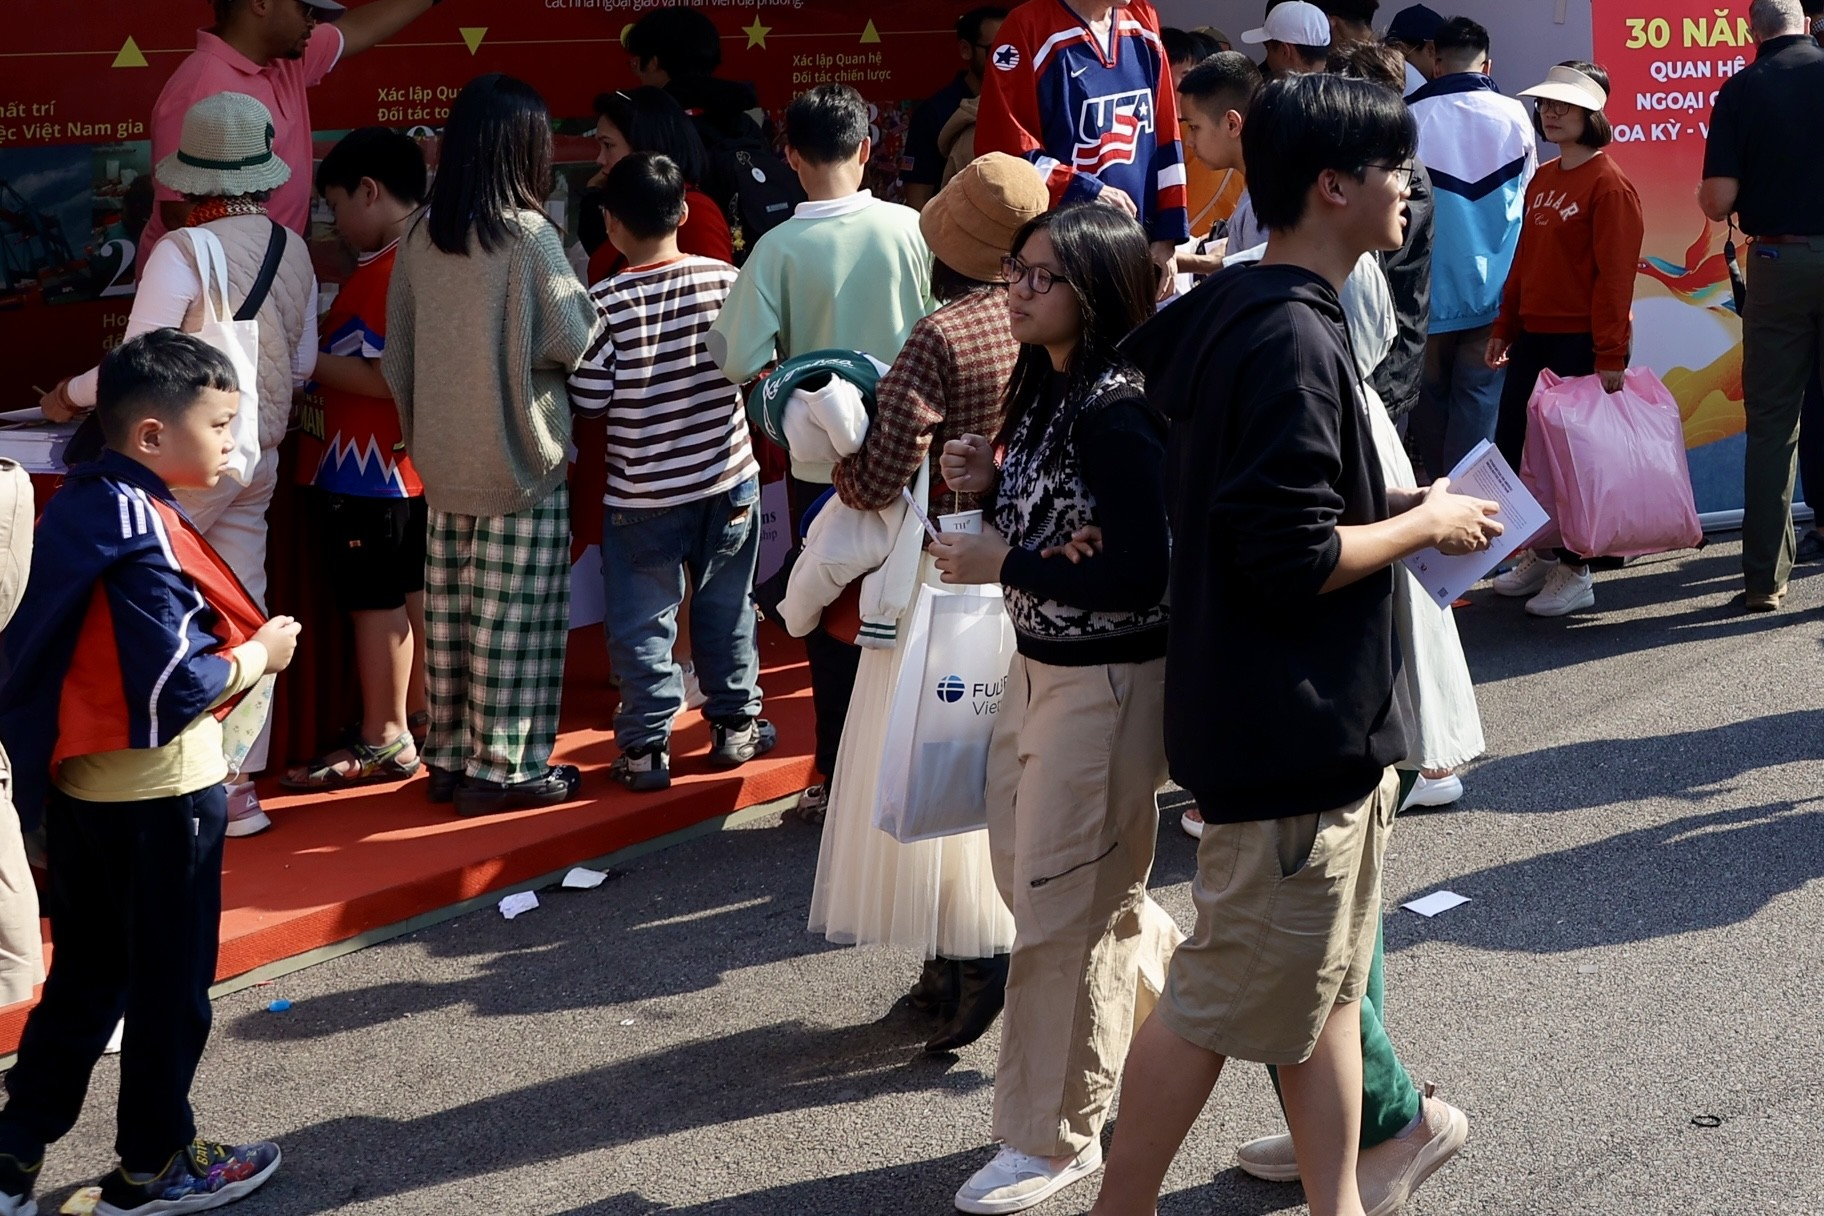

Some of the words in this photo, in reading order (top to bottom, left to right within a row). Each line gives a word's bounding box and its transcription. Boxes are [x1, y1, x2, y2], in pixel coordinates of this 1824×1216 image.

[1625, 17, 1670, 49] 30
[793, 53, 813, 67] Xác
[816, 52, 833, 68] lập
[836, 53, 865, 67] Quan
[868, 51, 882, 67] hệ
[793, 71, 812, 84] Đối
[814, 70, 832, 83] tác
[867, 68, 892, 83] lược
[1650, 61, 1711, 82] QUAN
[378, 87, 405, 102] Xác
[409, 85, 432, 103] lập
[1637, 92, 1703, 114] NGOẠI
[32, 100, 56, 116] trí
[377, 106, 403, 121] Đối
[408, 105, 431, 120] tác
[22, 123, 61, 143] Việt
[68, 121, 111, 138] Nam
[117, 119, 144, 139] gia
[1651, 119, 1681, 142] KỲ
[1525, 190, 1579, 222] OLAR
